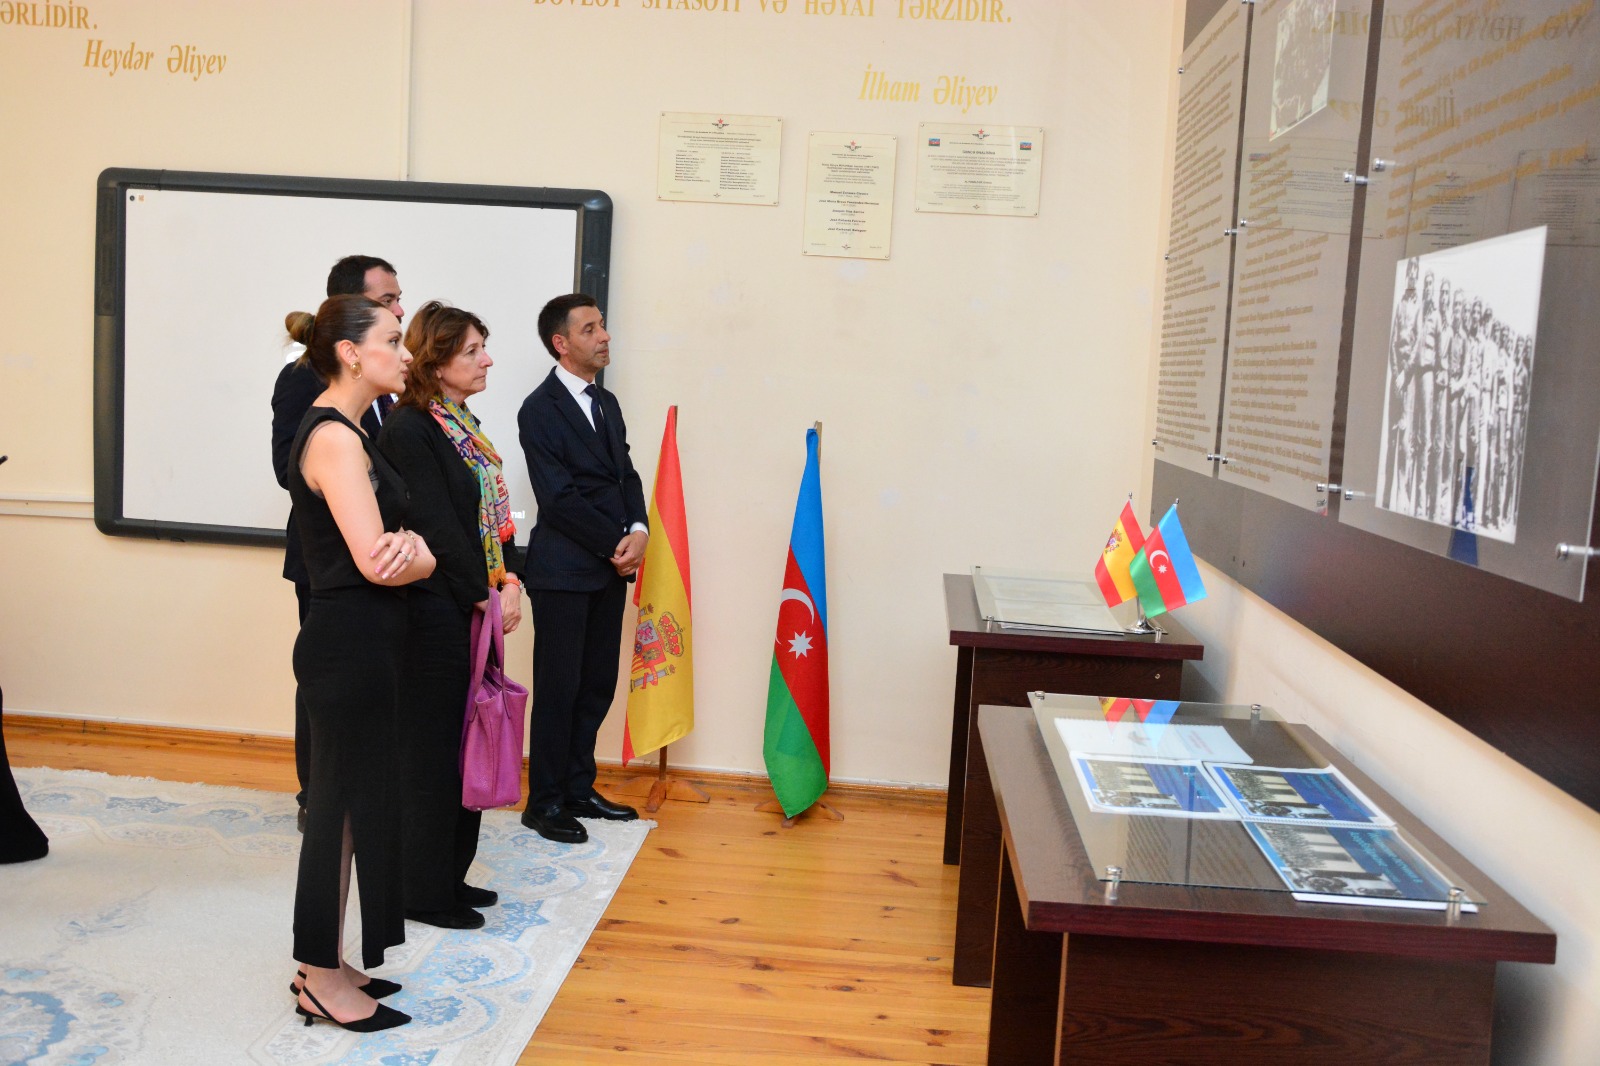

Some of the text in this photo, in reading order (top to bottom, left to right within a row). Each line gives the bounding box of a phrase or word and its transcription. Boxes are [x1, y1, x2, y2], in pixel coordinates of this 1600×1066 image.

[83, 39, 227, 81] Heydər Əliyev
[857, 63, 1000, 114] İlham Əliyev
